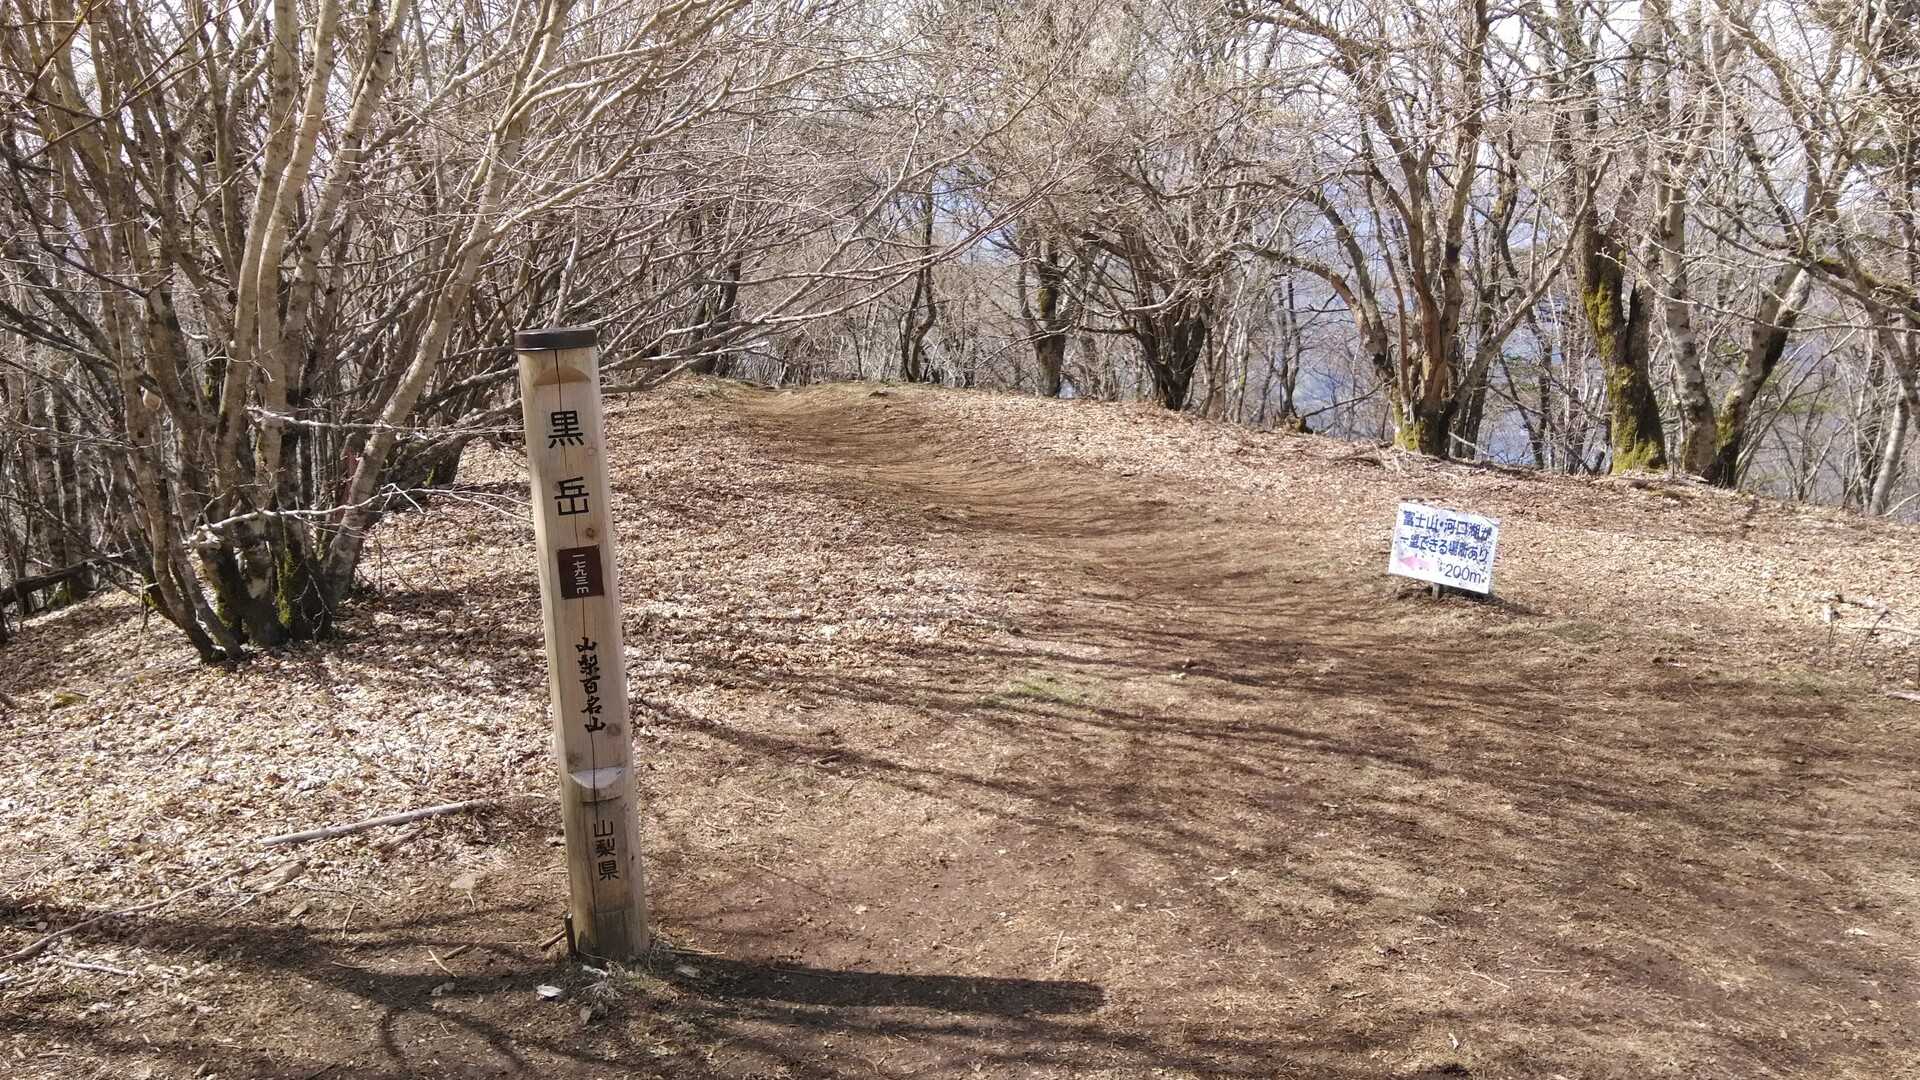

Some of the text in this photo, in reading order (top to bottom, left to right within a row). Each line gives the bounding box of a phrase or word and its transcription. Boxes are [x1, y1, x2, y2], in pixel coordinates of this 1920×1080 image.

[548, 410, 590, 516] 黒岳
[575, 636, 606, 733] 山梨百名山
[593, 819, 618, 881] 山梨県
